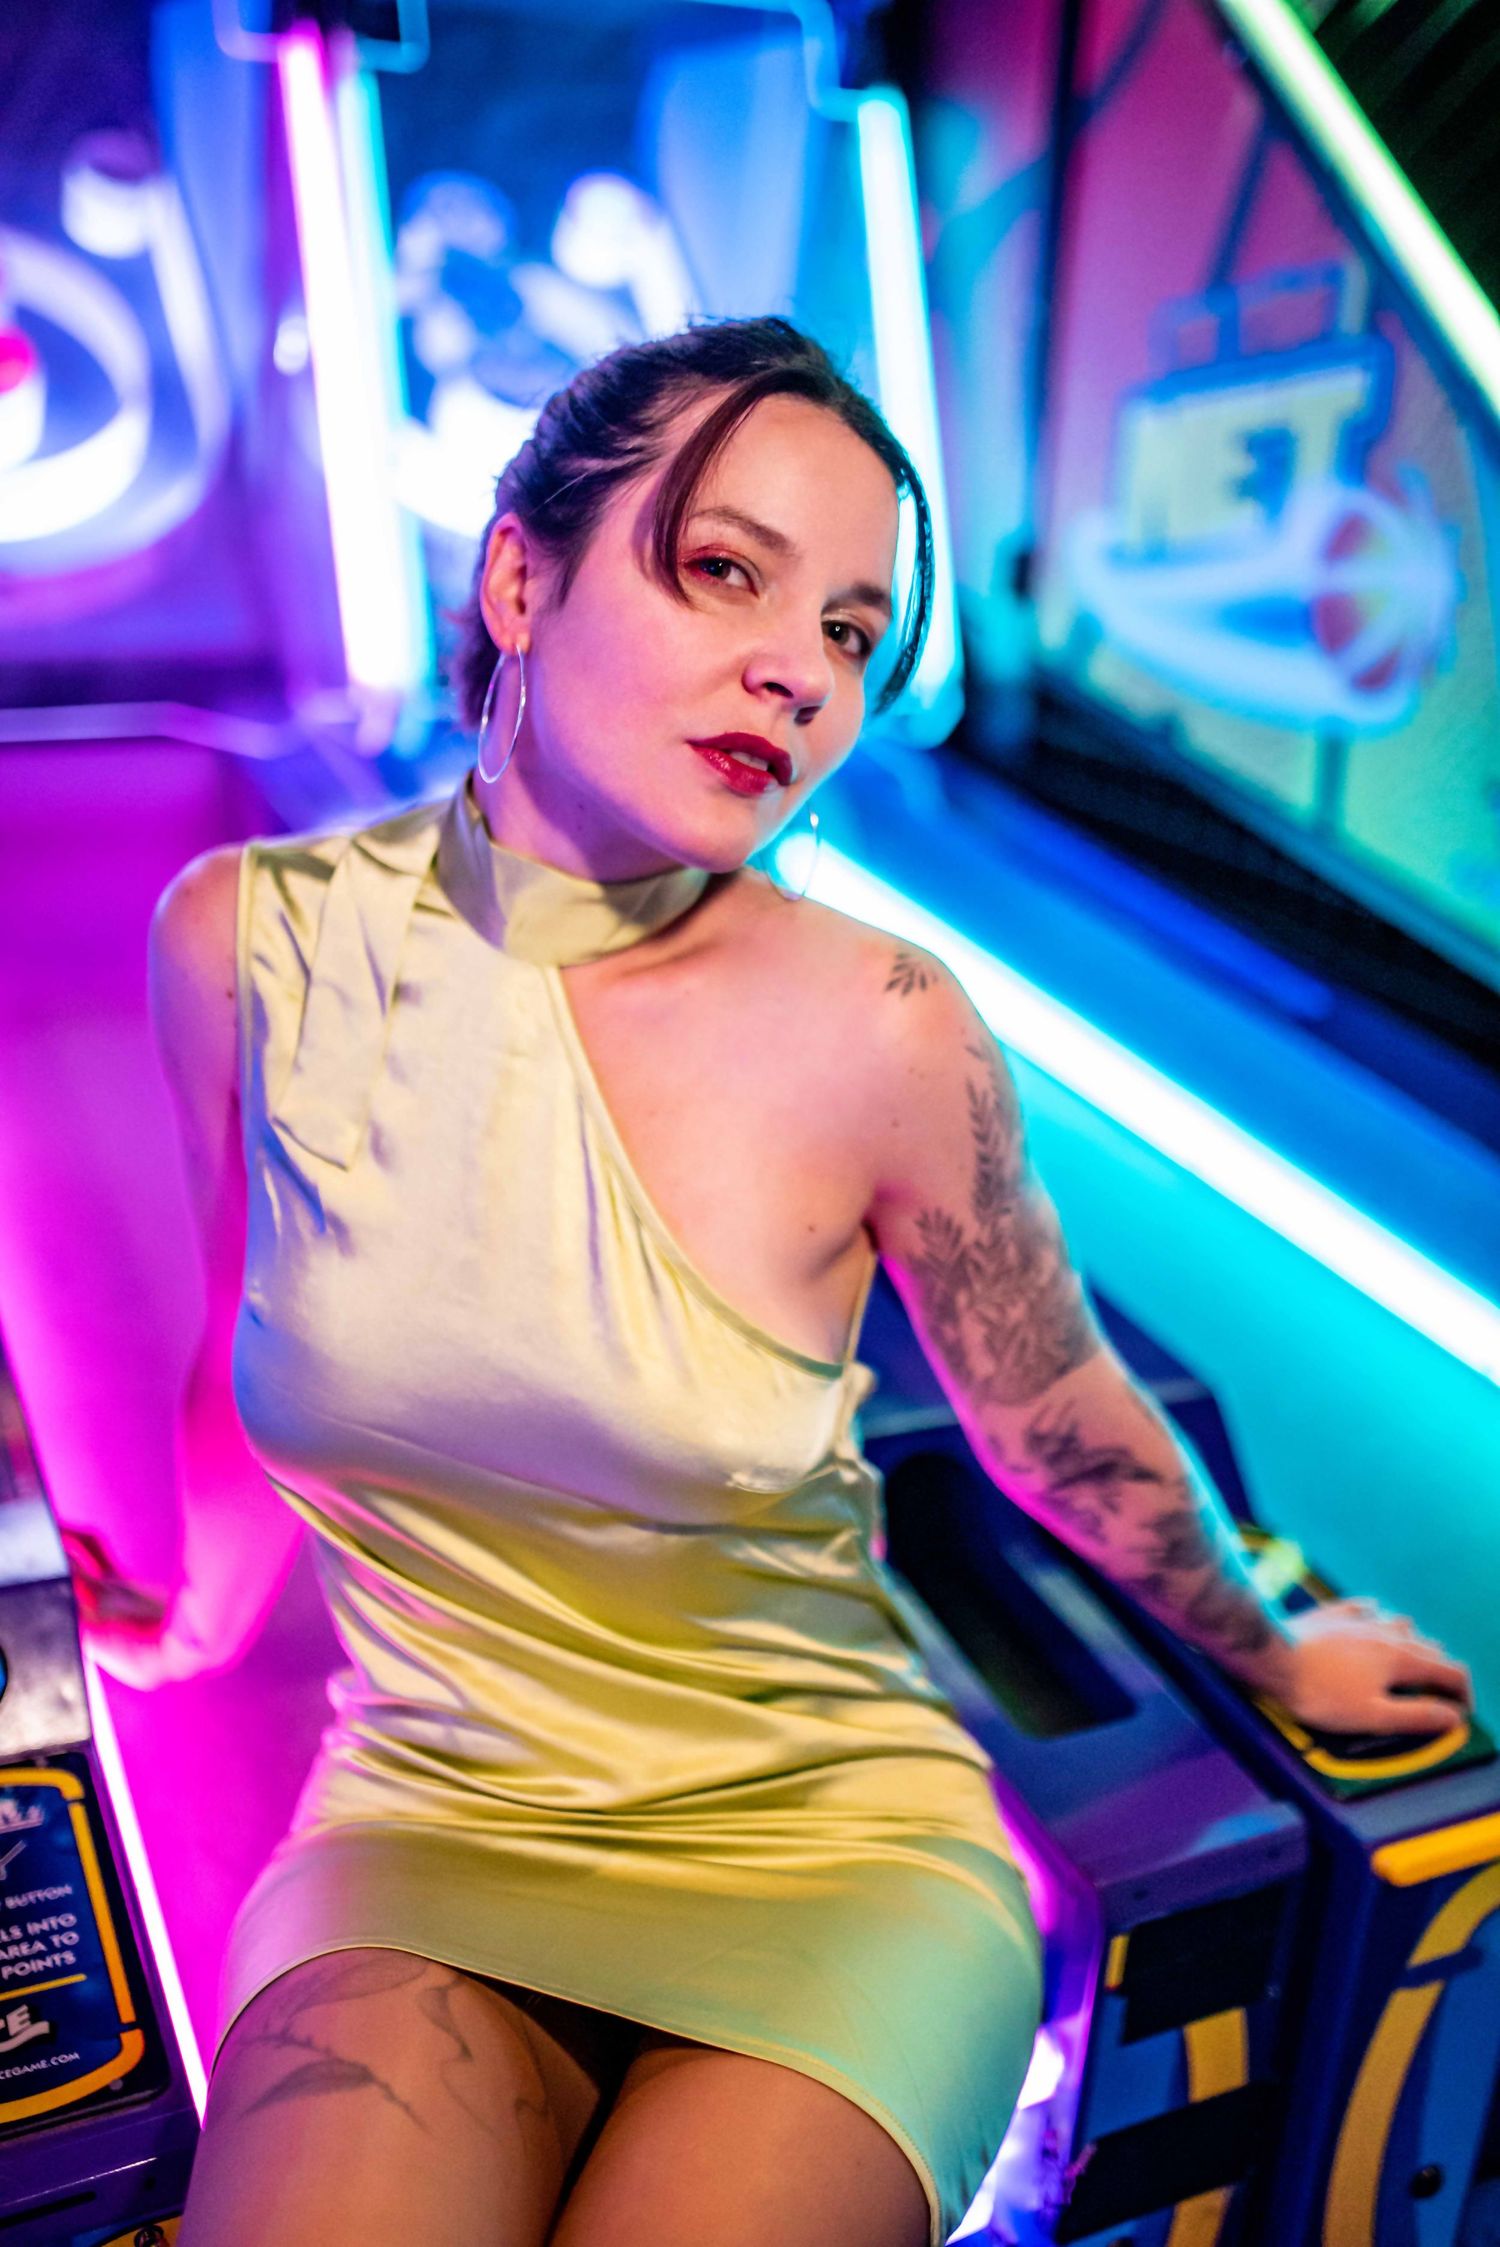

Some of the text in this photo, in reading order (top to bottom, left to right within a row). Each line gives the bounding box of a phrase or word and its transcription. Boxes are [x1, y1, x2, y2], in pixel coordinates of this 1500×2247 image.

[5, 1884, 73, 1909] BUTTON
[26, 1913, 77, 1935] INTO
[49, 1931, 80, 1948] TO
[1, 1950, 76, 1980] POINTS
